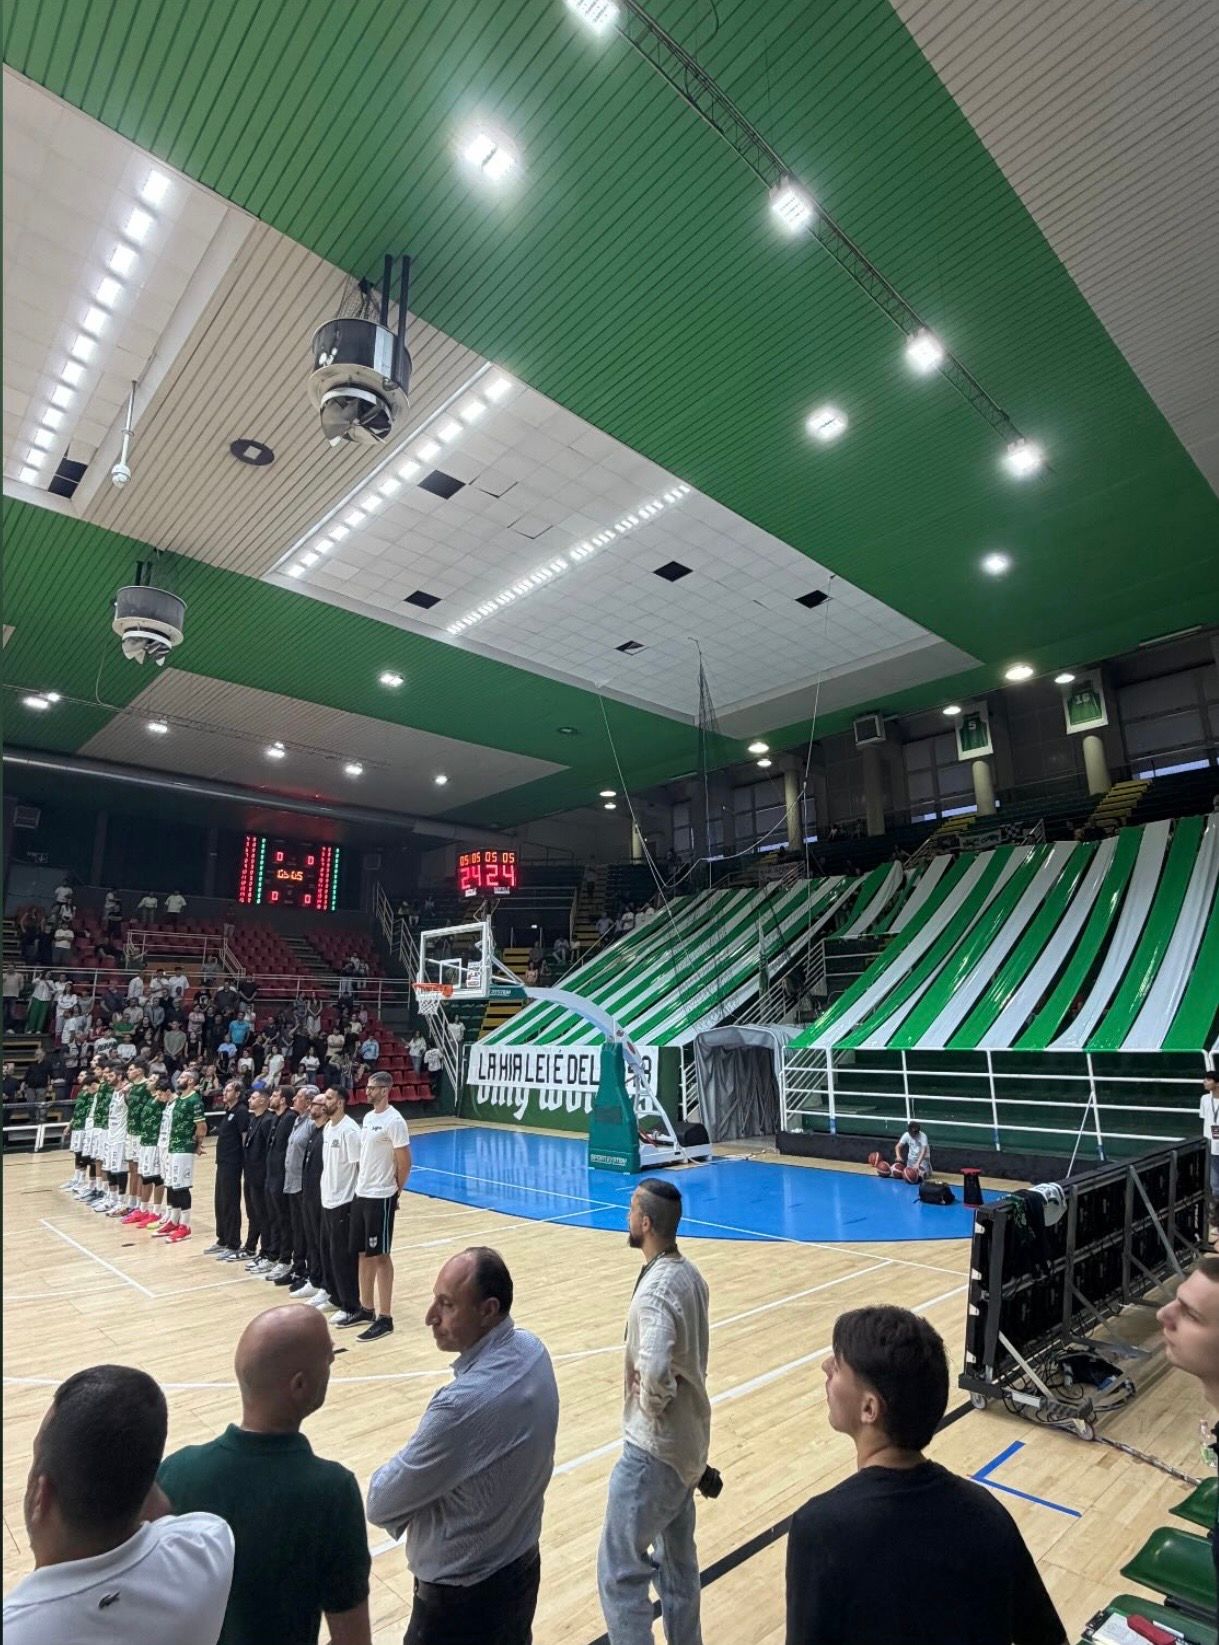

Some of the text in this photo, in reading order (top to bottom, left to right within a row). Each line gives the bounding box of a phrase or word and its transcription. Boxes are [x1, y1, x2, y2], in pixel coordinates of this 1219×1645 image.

[968, 720, 977, 730] 5
[276, 851, 284, 862] 0
[307, 855, 315, 865] 0
[485, 851, 515, 864] 05 05
[486, 864, 515, 887] 24
[271, 890, 279, 901] 0
[304, 894, 312, 904] 0
[478, 1052, 496, 1081] LA
[525, 1053, 550, 1083] LEI
[567, 1054, 600, 1086] DEL
